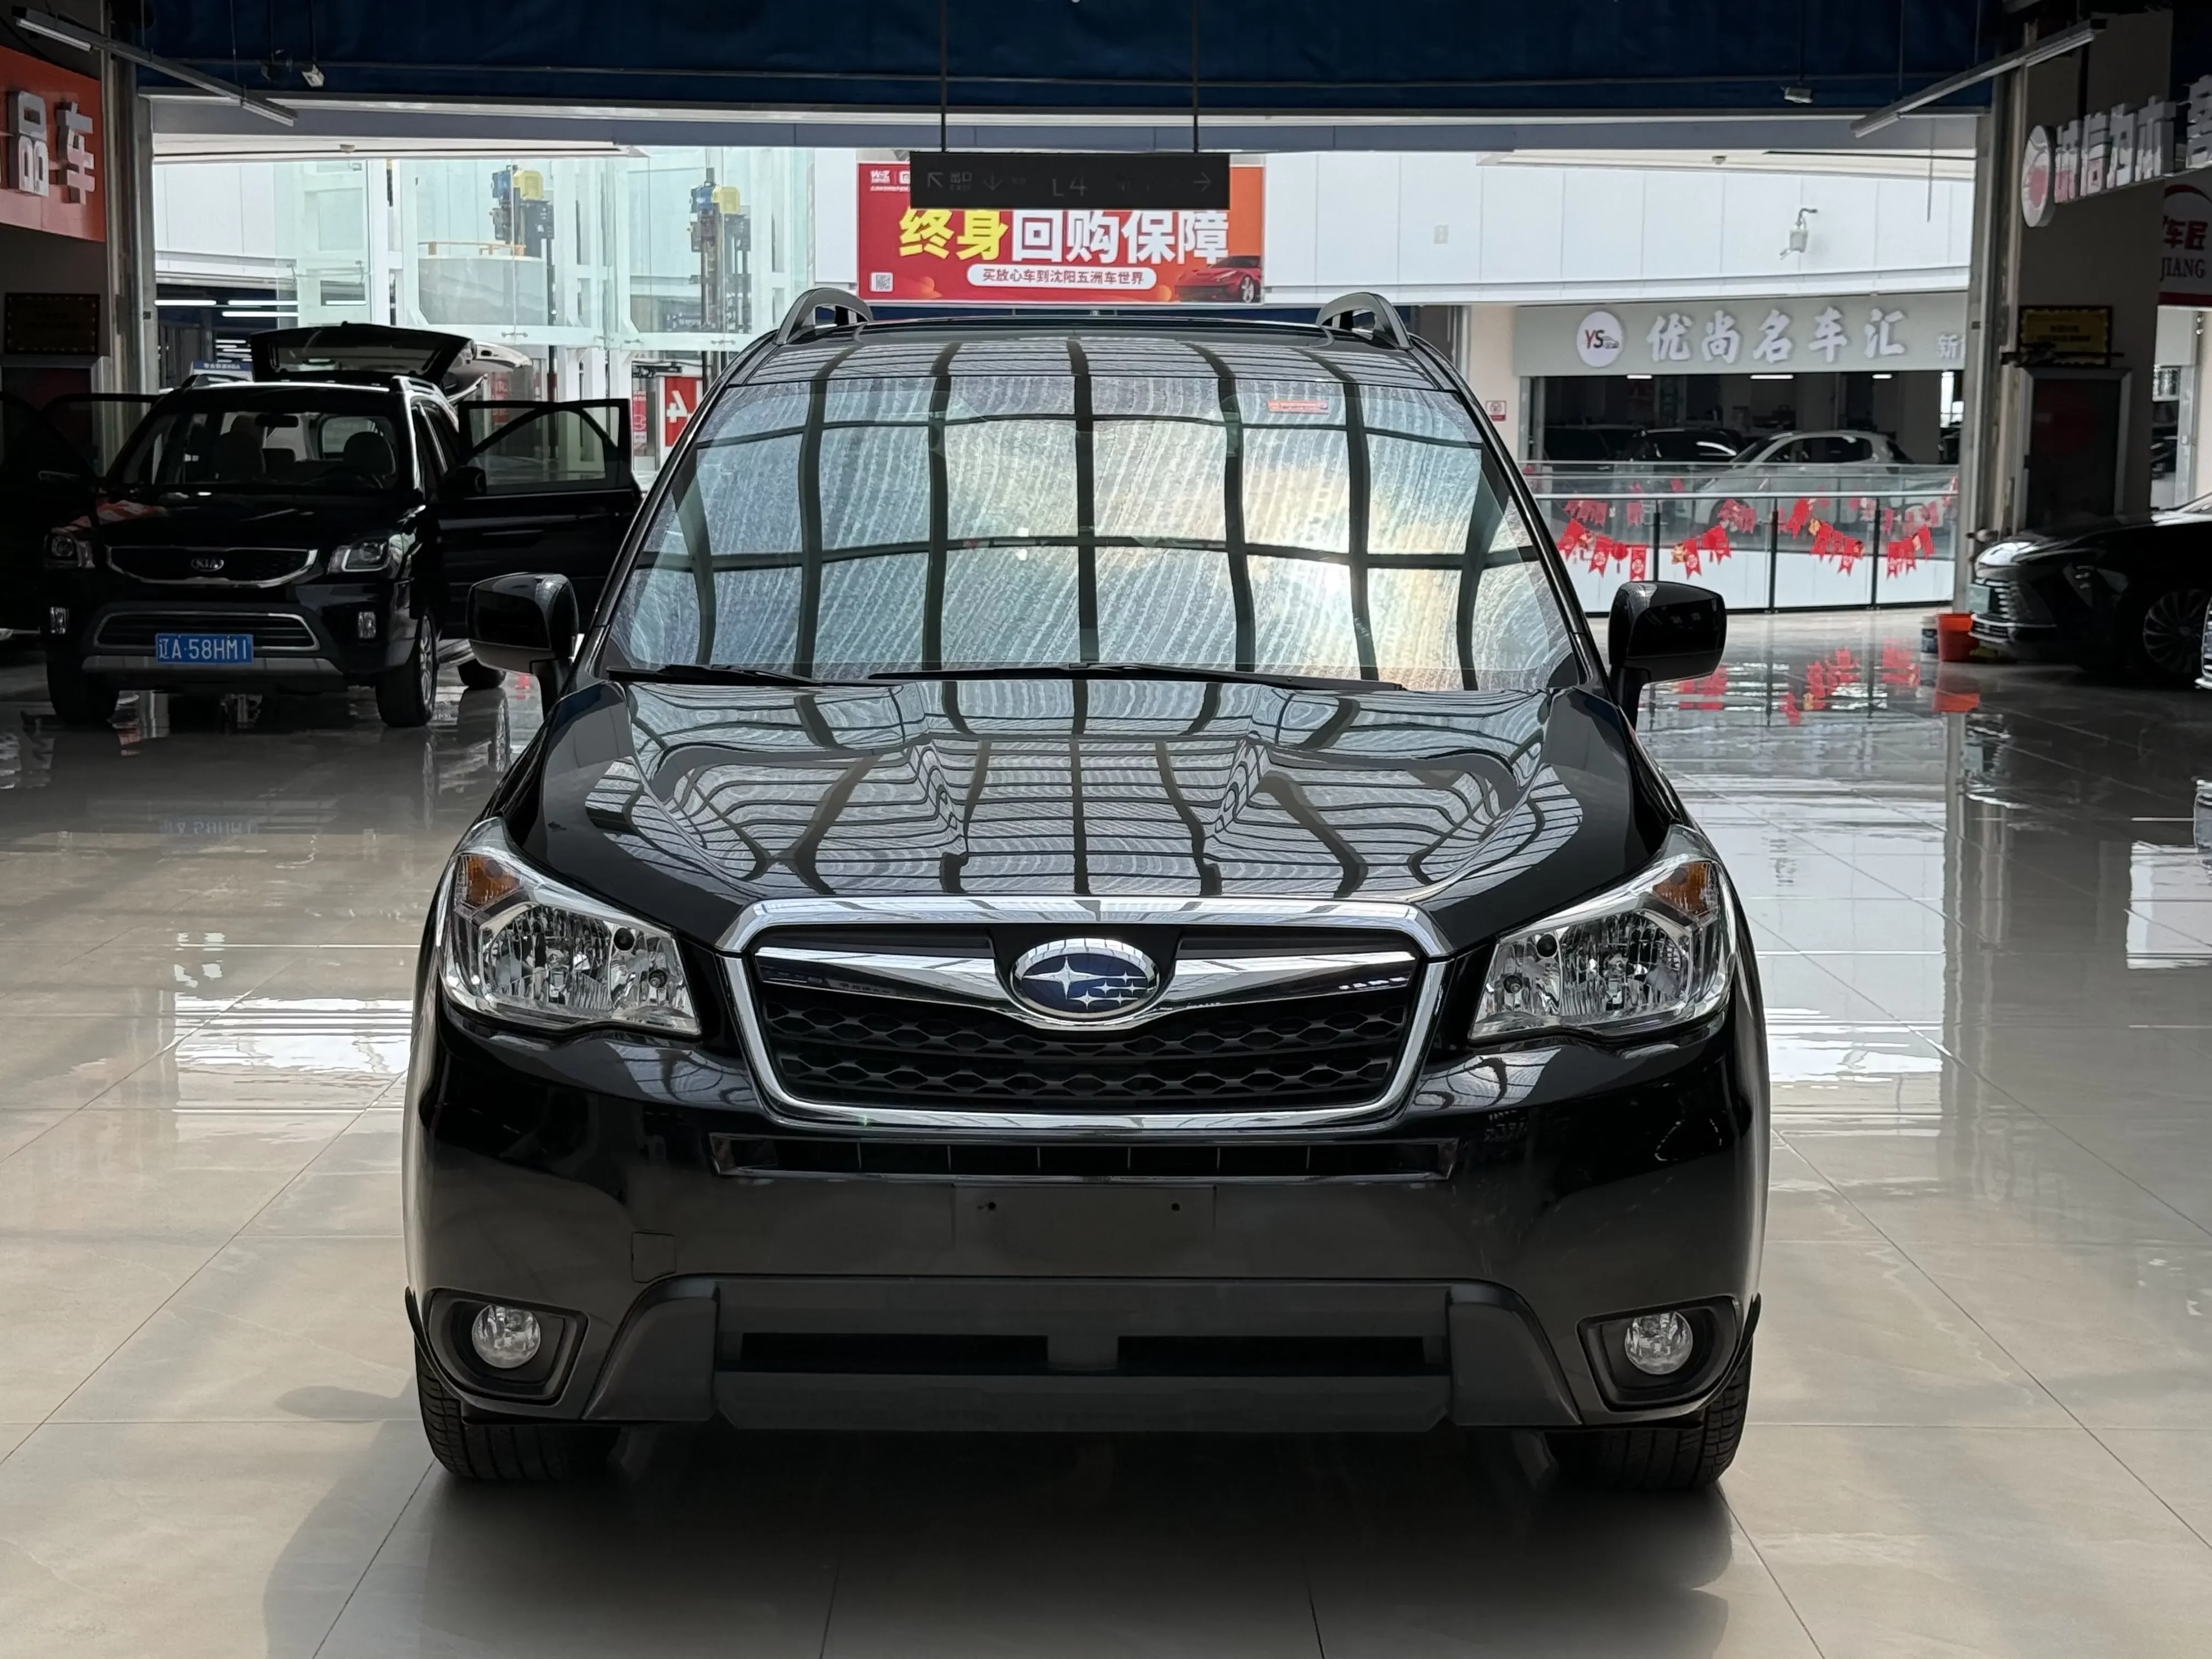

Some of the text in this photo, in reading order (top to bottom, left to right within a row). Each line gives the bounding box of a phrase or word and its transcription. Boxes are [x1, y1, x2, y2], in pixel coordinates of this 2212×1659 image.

[950, 171, 973, 183] 出口
[1051, 169, 1087, 197] L4
[898, 207, 1229, 265] 终身回购保障
[981, 268, 1146, 286] 买放心车到沈阳五洲车世界
[1584, 330, 1605, 349] YS
[1646, 306, 1966, 364] 优尚名车汇 新
